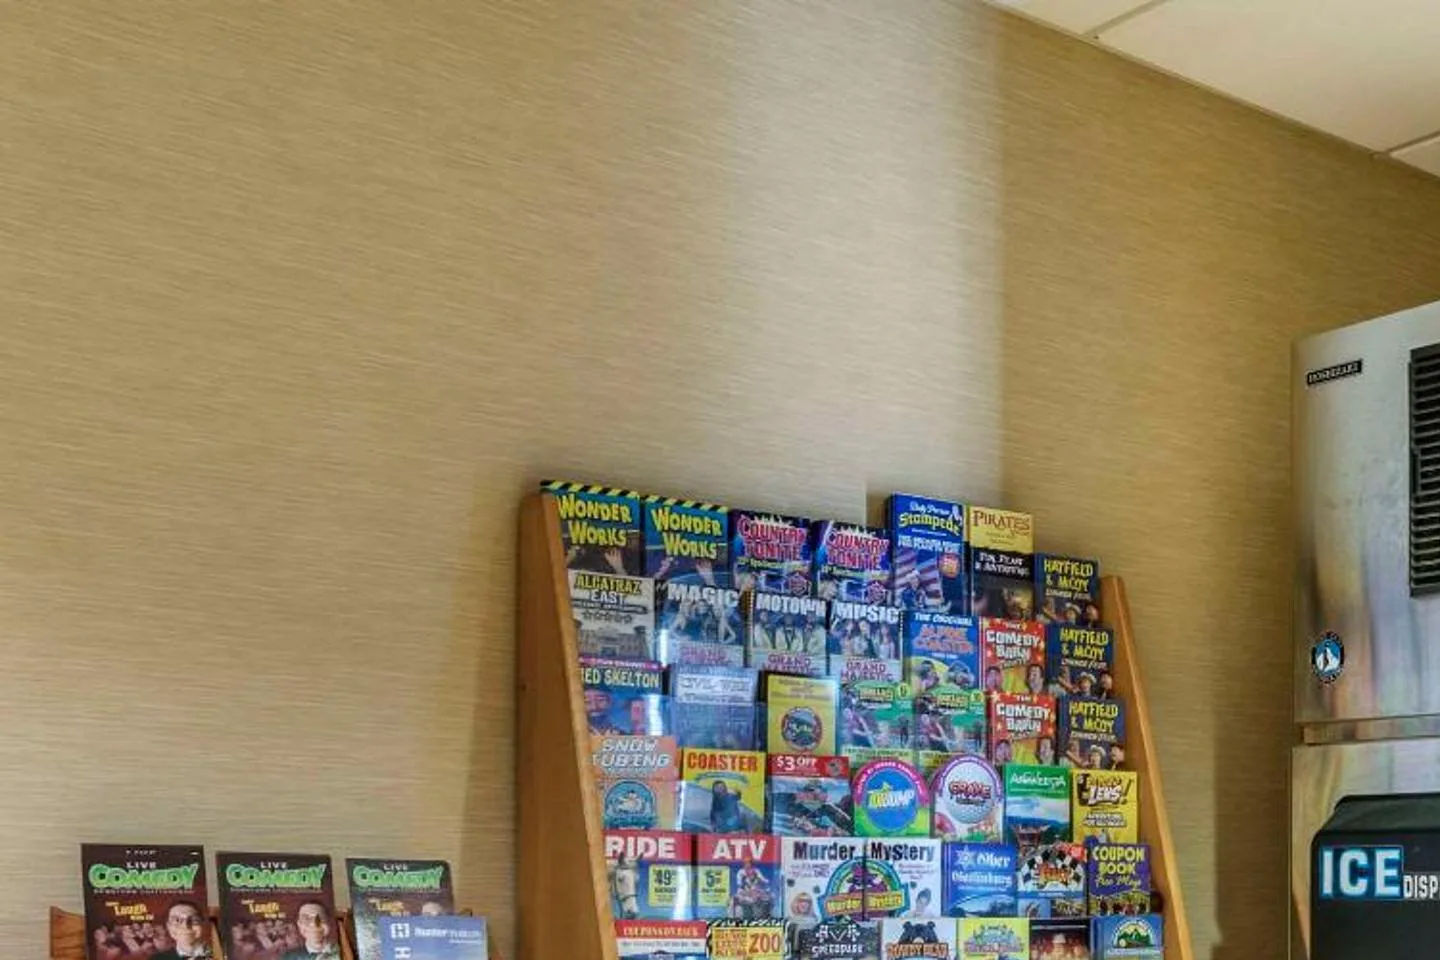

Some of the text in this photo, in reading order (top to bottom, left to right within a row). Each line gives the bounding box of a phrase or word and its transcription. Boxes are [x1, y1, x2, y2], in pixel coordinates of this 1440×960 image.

[556, 493, 632, 523] WONDER
[652, 507, 721, 537] WONDER
[973, 510, 1030, 531] PIRATES
[568, 521, 627, 547] WORKS
[664, 532, 717, 560] WORKS
[1043, 559, 1093, 577] HATFIELD
[574, 574, 642, 594] ALCATRAZ
[667, 583, 741, 607] MAGIC
[756, 592, 826, 616] MOTOWN
[836, 602, 900, 625] MUSIC
[986, 631, 1041, 648] COMEDY
[1059, 627, 1109, 646] HATFIELD
[605, 670, 661, 689] SKELTON
[997, 703, 1050, 719] COMEDY
[1068, 701, 1118, 718] HATFIELD
[602, 738, 657, 752] SNOW
[686, 752, 758, 772] COASTER
[604, 835, 676, 860] RIDE
[713, 839, 766, 860] ATV
[793, 841, 935, 862] Murder Mystery
[1092, 845, 1144, 861] COUPON
[127, 861, 156, 869] LIVE
[260, 861, 287, 869] LIVE
[1098, 861, 1136, 875] BOOK
[1321, 848, 1401, 897] ICE
[89, 863, 198, 889] COMEDY
[226, 863, 327, 889] COMEDY
[353, 865, 444, 889] COMEDY
[750, 932, 781, 954] ZOO
